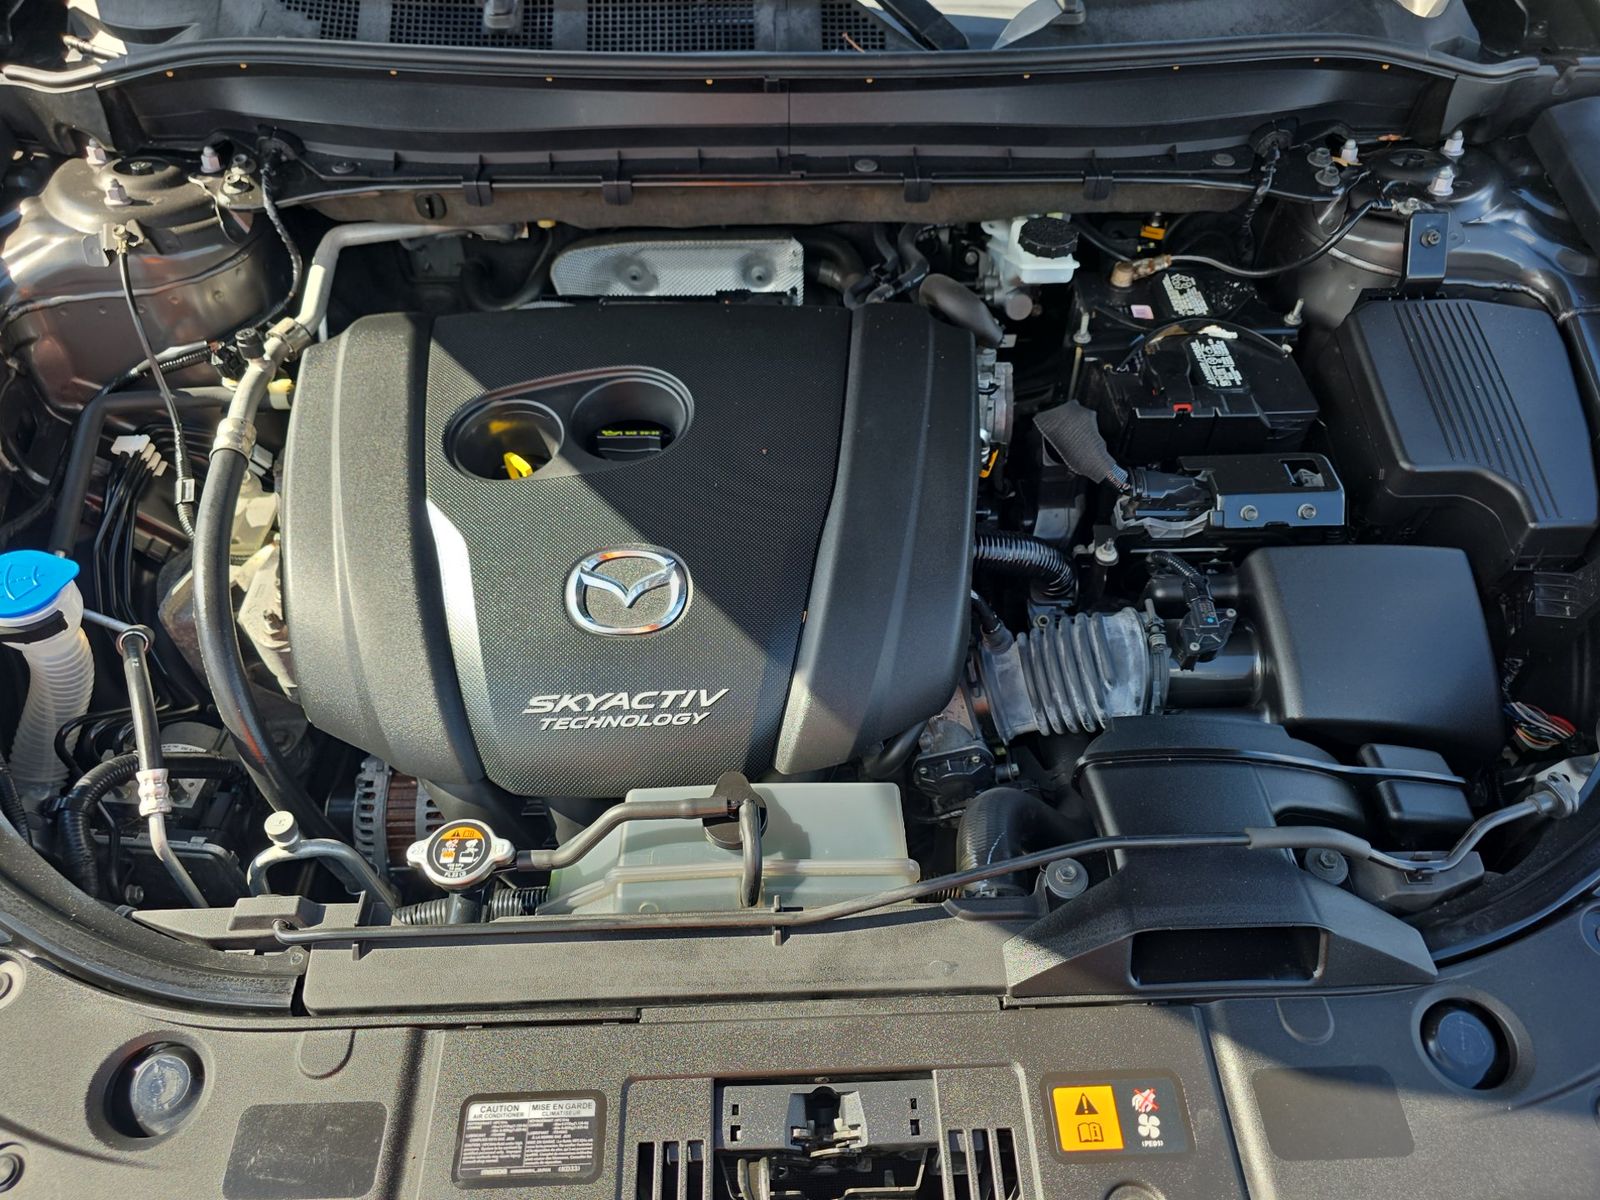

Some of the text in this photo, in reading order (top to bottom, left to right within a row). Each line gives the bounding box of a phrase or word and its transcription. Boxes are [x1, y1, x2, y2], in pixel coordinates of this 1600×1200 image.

[522, 688, 730, 714] SKYACTIV
[540, 711, 711, 731] TECHNOLOGY
[480, 1104, 520, 1113] CAUTION
[531, 1101, 593, 1111] MISE EN GARDE
